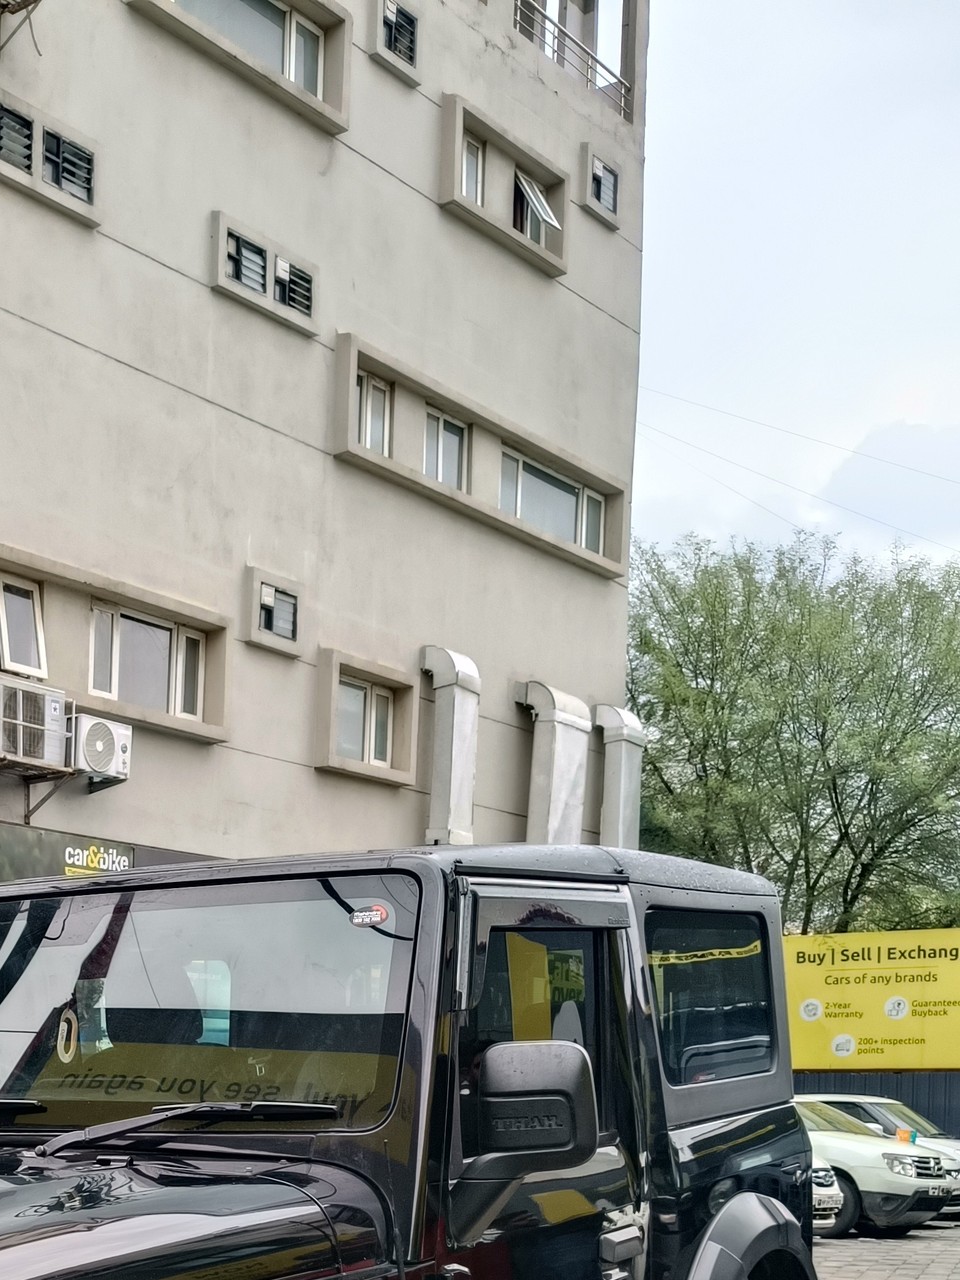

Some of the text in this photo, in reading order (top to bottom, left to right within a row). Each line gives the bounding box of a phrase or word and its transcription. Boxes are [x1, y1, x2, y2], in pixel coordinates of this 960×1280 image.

[64, 845, 129, 872] car&bike
[796, 951, 826, 966] Buy
[840, 947, 872, 962] Sell
[825, 972, 938, 986] Cars of any brands
[825, 1002, 851, 1010] 2-Year
[825, 1009, 948, 1019] Warranty Buyback
[857, 1037, 926, 1046] 200+ inspection
[857, 1046, 884, 1055] points
[492, 1114, 563, 1131] THAR
